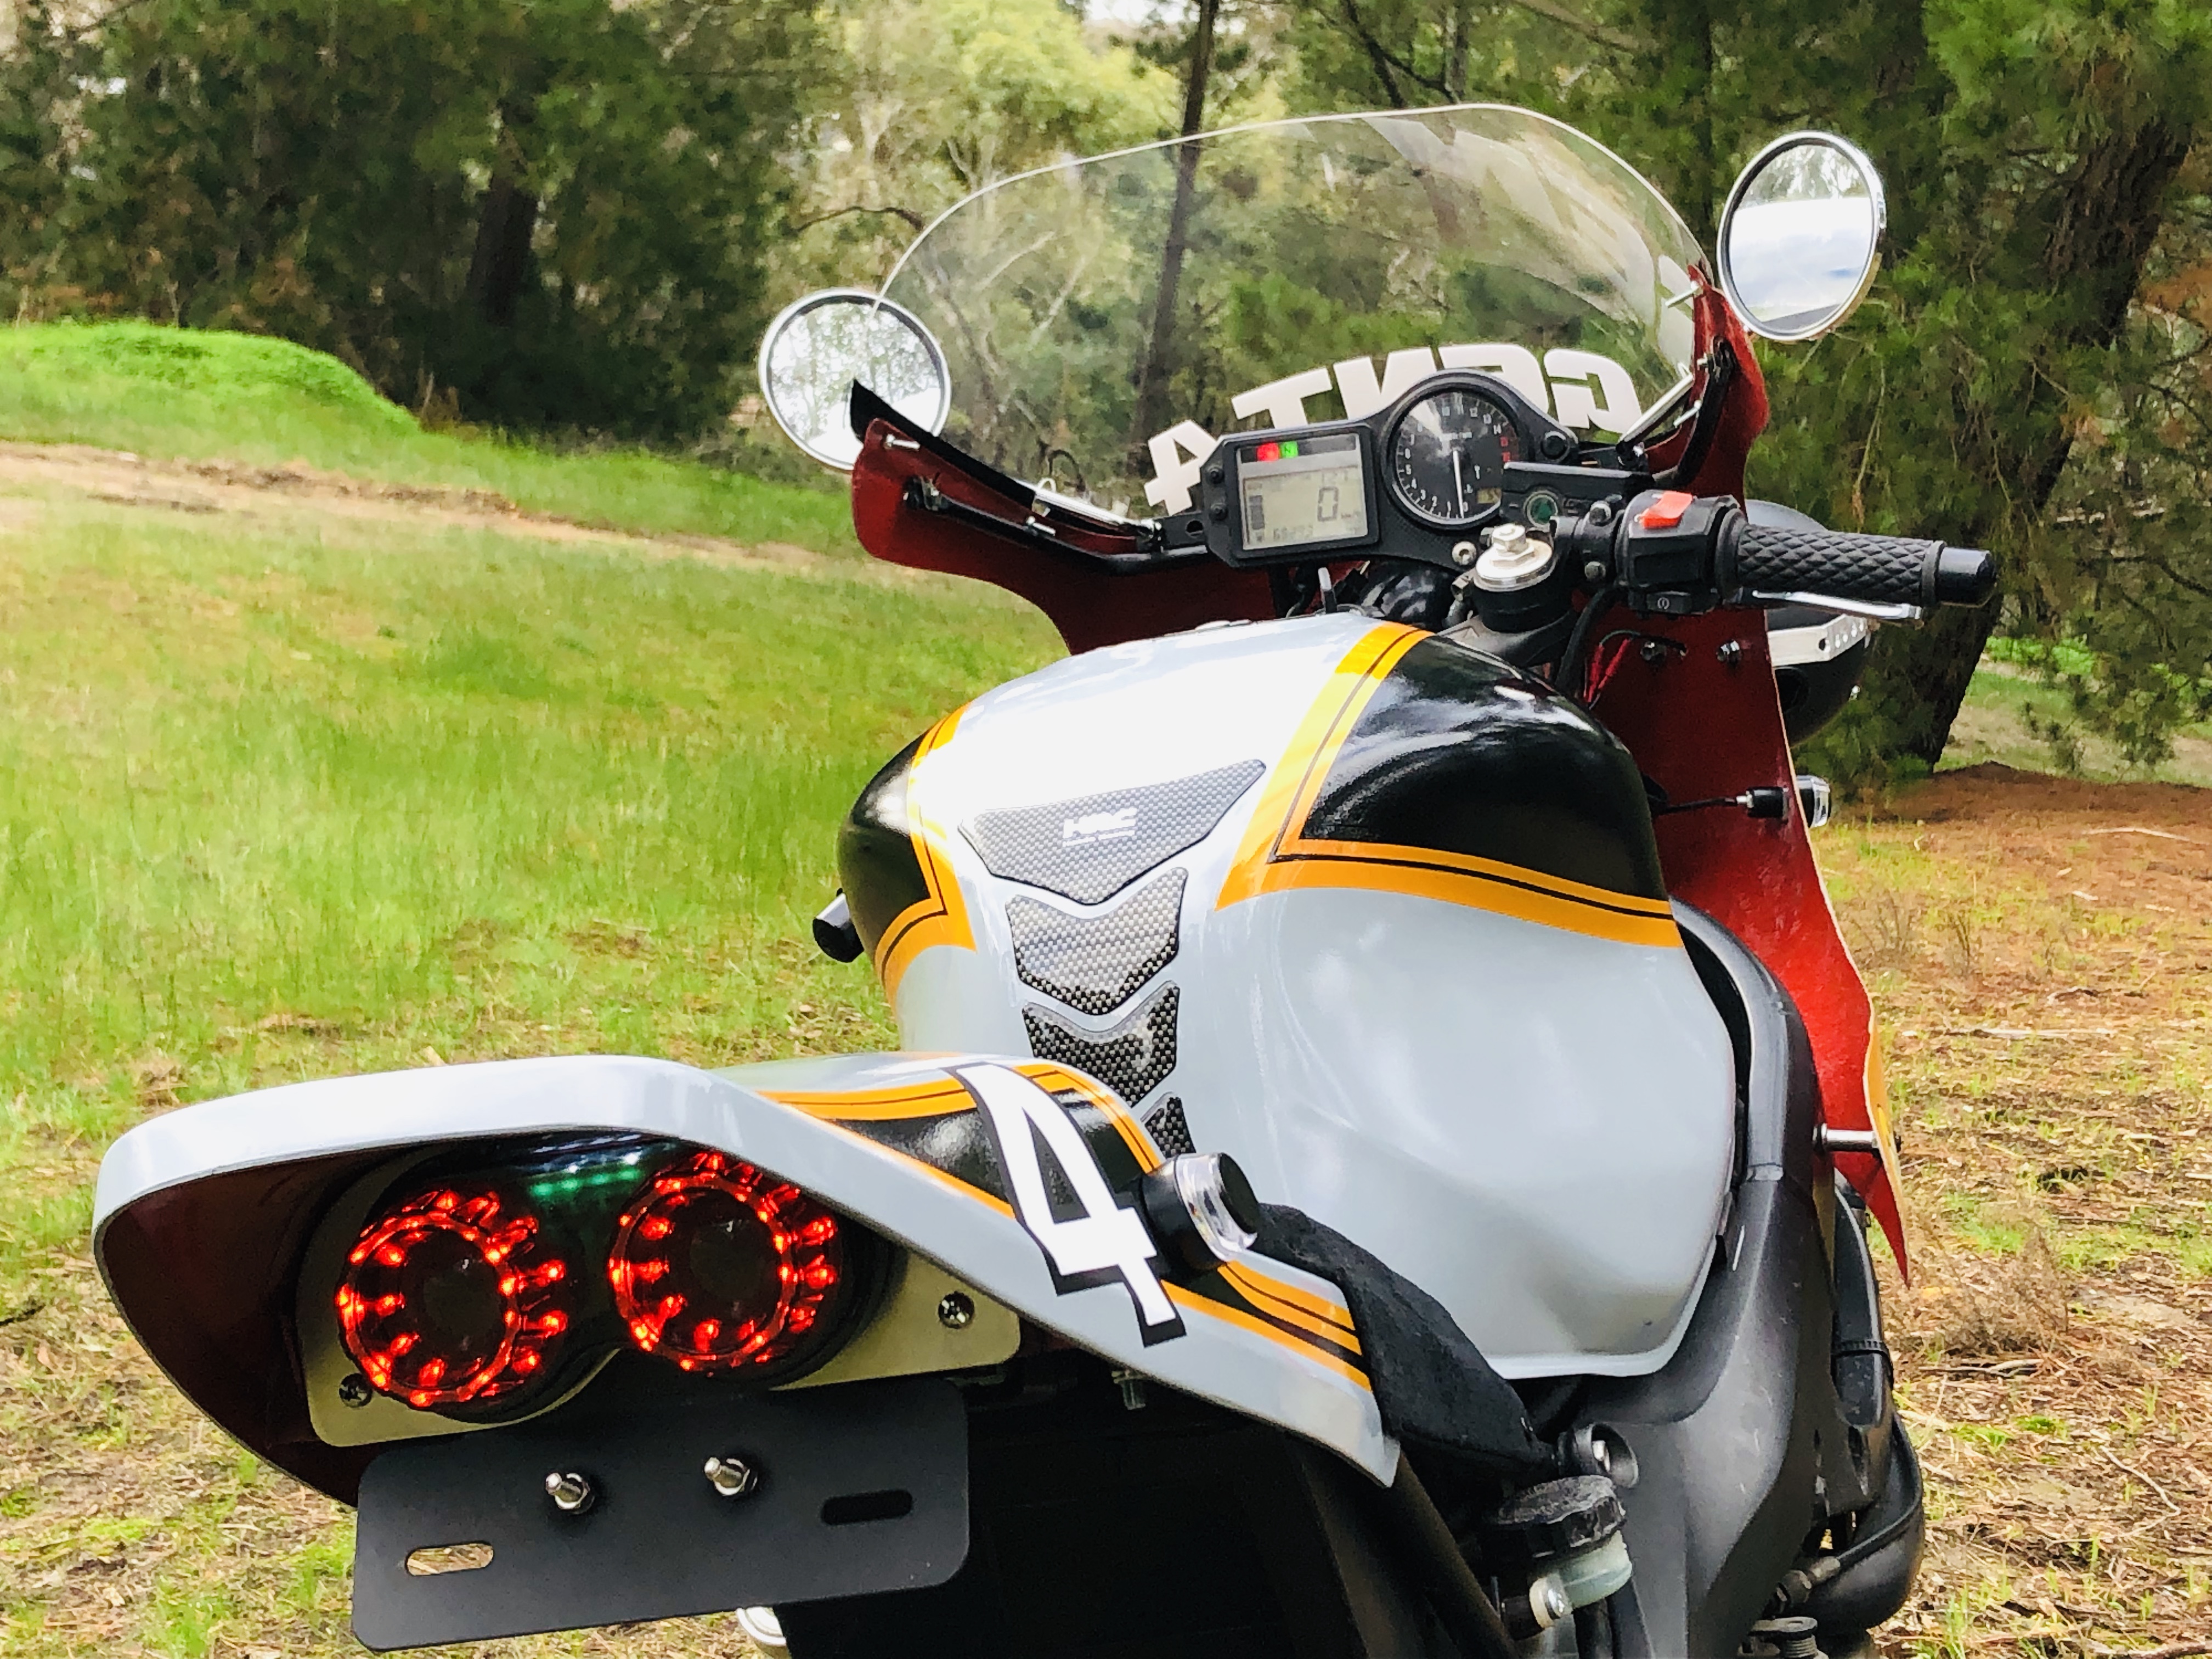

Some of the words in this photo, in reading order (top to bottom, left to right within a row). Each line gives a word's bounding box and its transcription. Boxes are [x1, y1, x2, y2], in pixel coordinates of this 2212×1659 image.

[1405, 464, 1412, 475] 5
[1410, 478, 1417, 489] 4
[1420, 489, 1426, 500] 3
[1317, 486, 1339, 522] 0
[1431, 495, 1437, 507] 2
[953, 1063, 1179, 1331] 4
